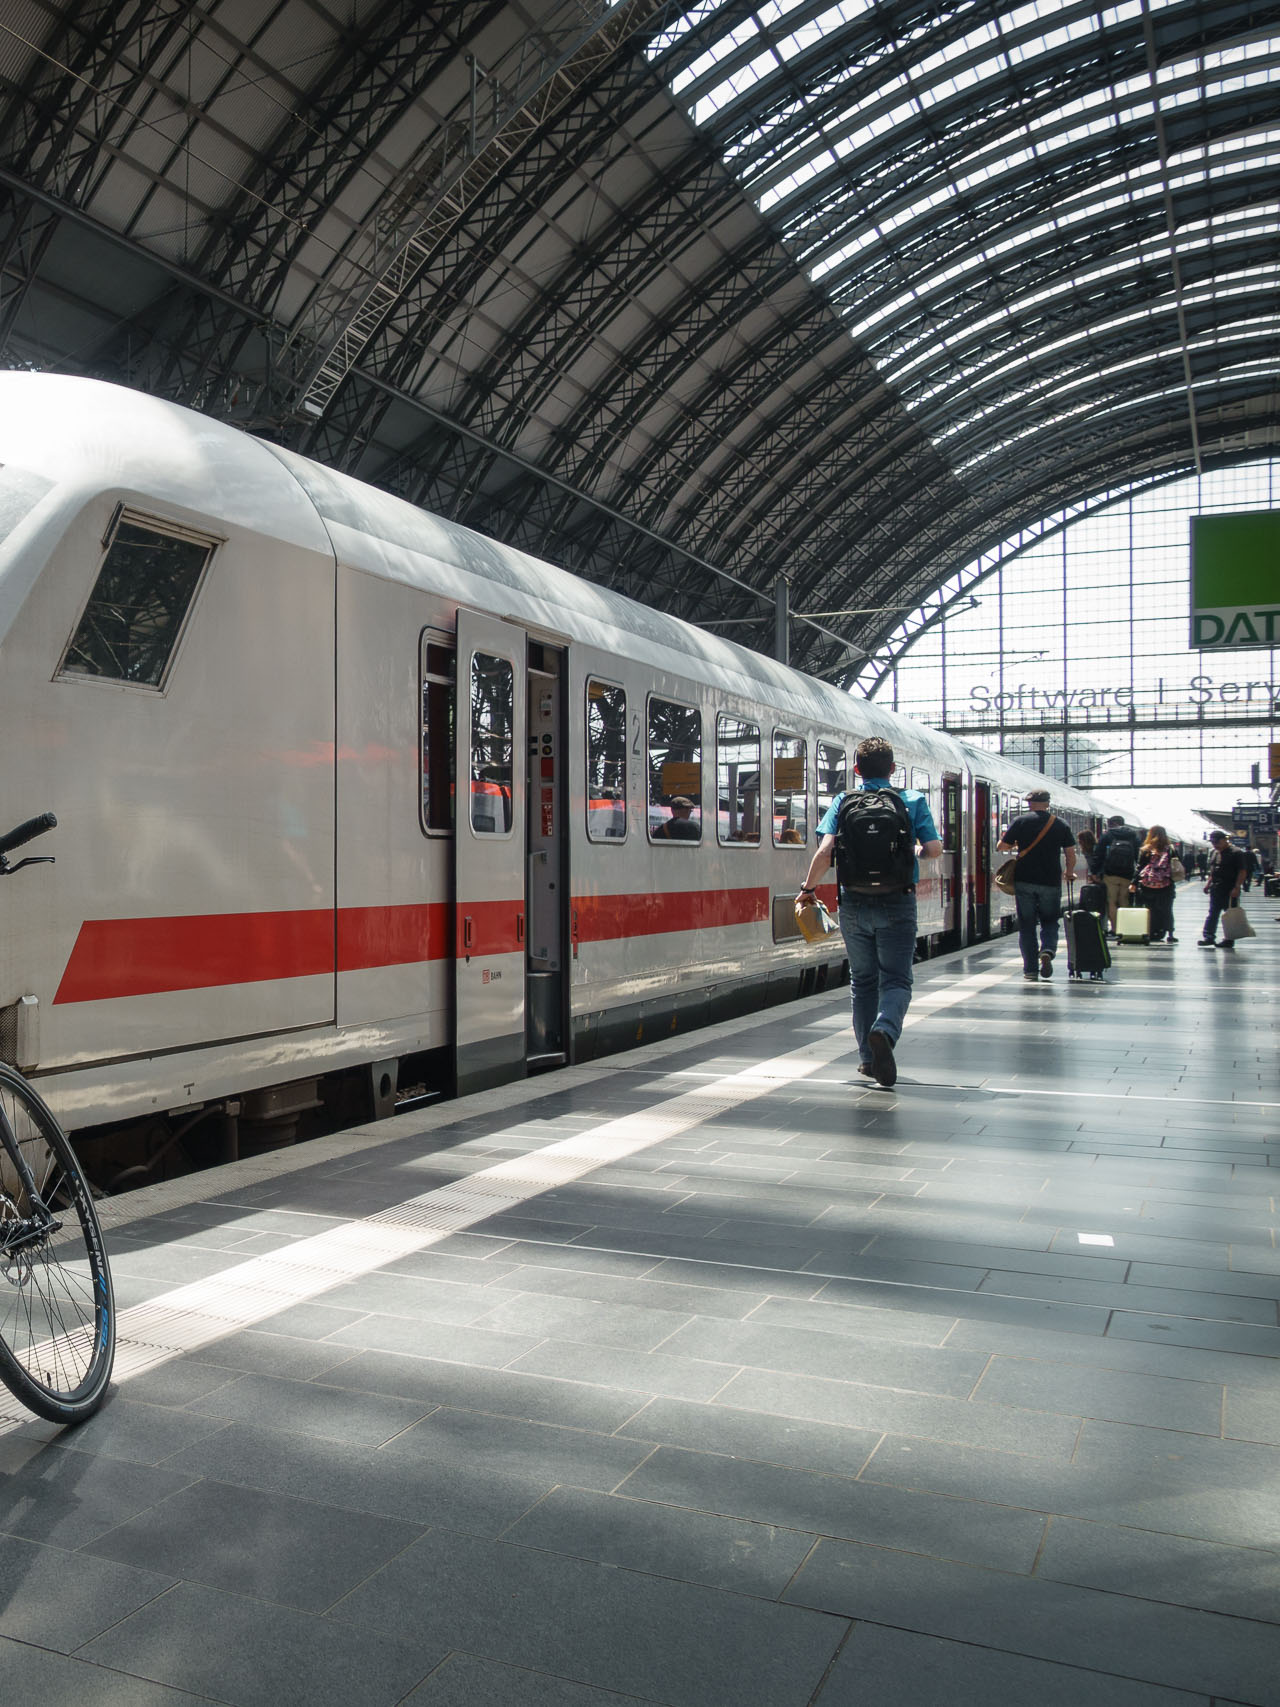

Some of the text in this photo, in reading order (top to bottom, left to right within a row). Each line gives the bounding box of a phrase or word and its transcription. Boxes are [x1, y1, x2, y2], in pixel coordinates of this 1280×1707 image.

[1194, 611, 1280, 645] DAT
[970, 684, 1133, 713] Software
[1189, 676, 1280, 704] Serv
[632, 713, 641, 756] 2
[75, 1178, 103, 1268] OXYGEN
